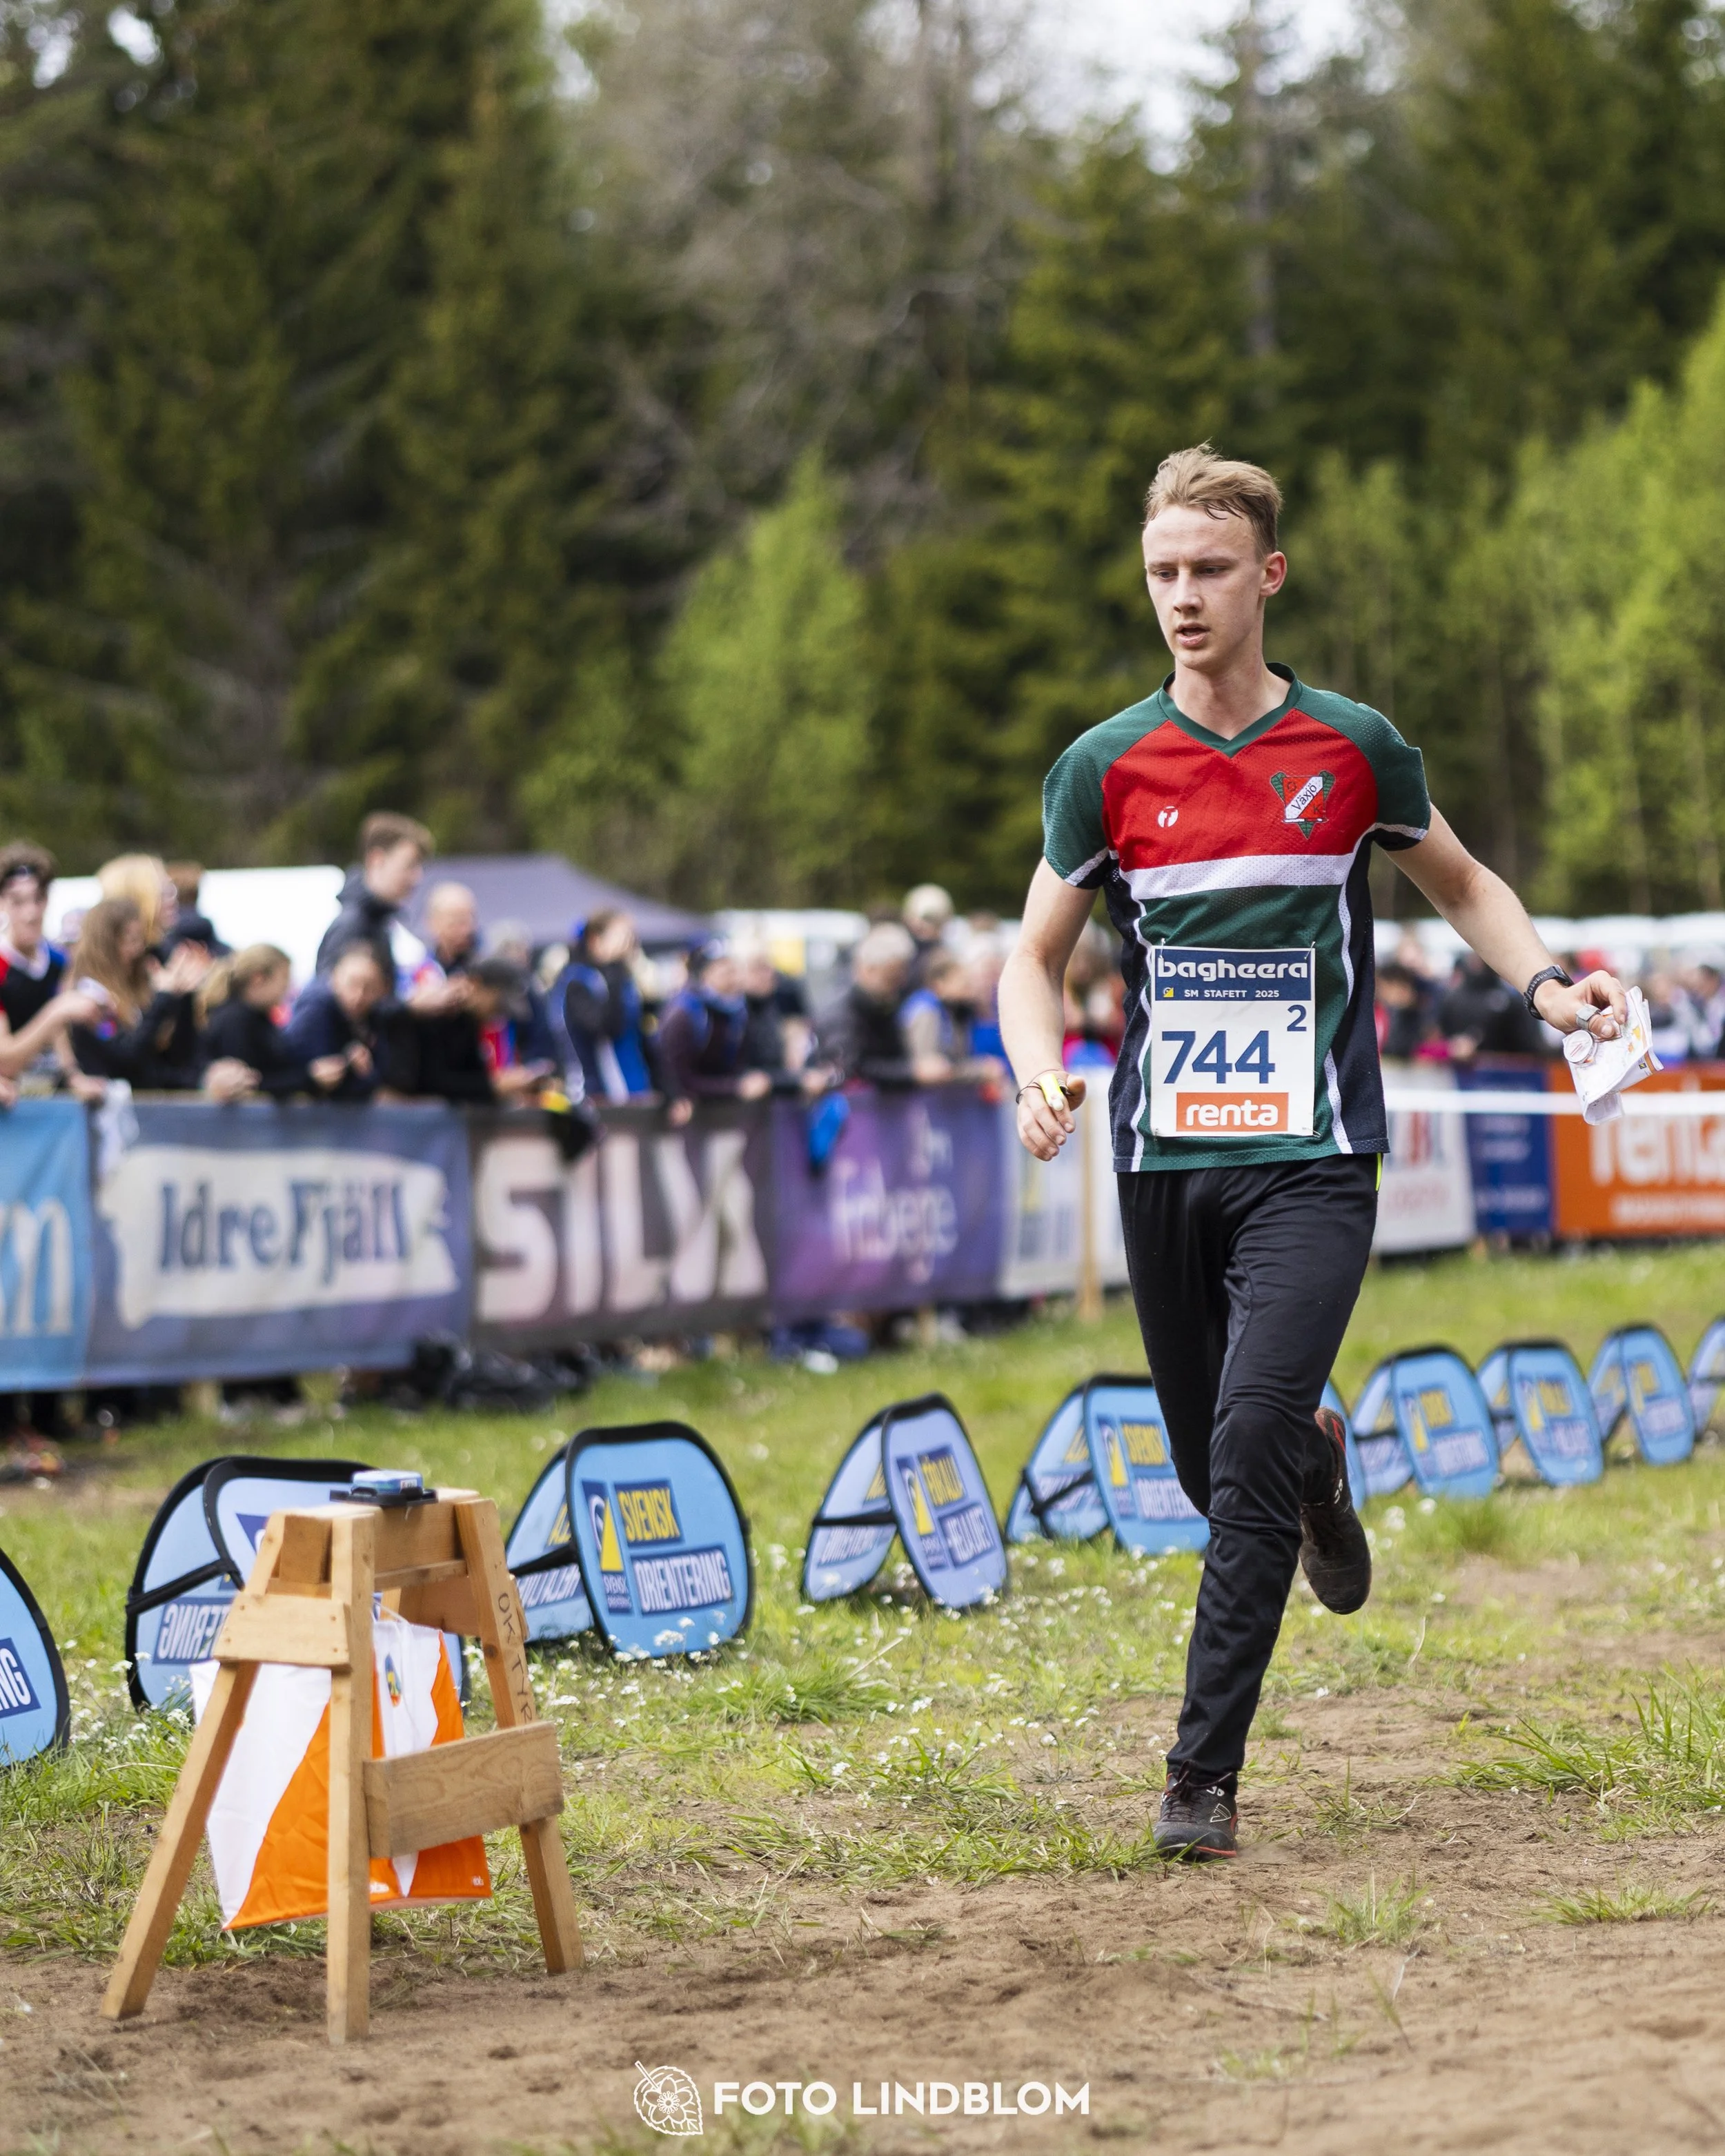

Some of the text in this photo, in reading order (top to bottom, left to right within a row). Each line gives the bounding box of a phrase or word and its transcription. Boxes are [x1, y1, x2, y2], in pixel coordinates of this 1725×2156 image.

[1290, 782, 1317, 811] Växjö
[1157, 959, 1308, 982] bagheera
[1184, 989, 1280, 998] SM STAFETT 2025
[1287, 1005, 1307, 1031] 2
[1162, 1030, 1276, 1084] 744
[1186, 1099, 1279, 1127] renta
[618, 1487, 680, 1542] SVENSK
[634, 1549, 731, 1613] ORIENTERING
[498, 1592, 515, 1644] OK
